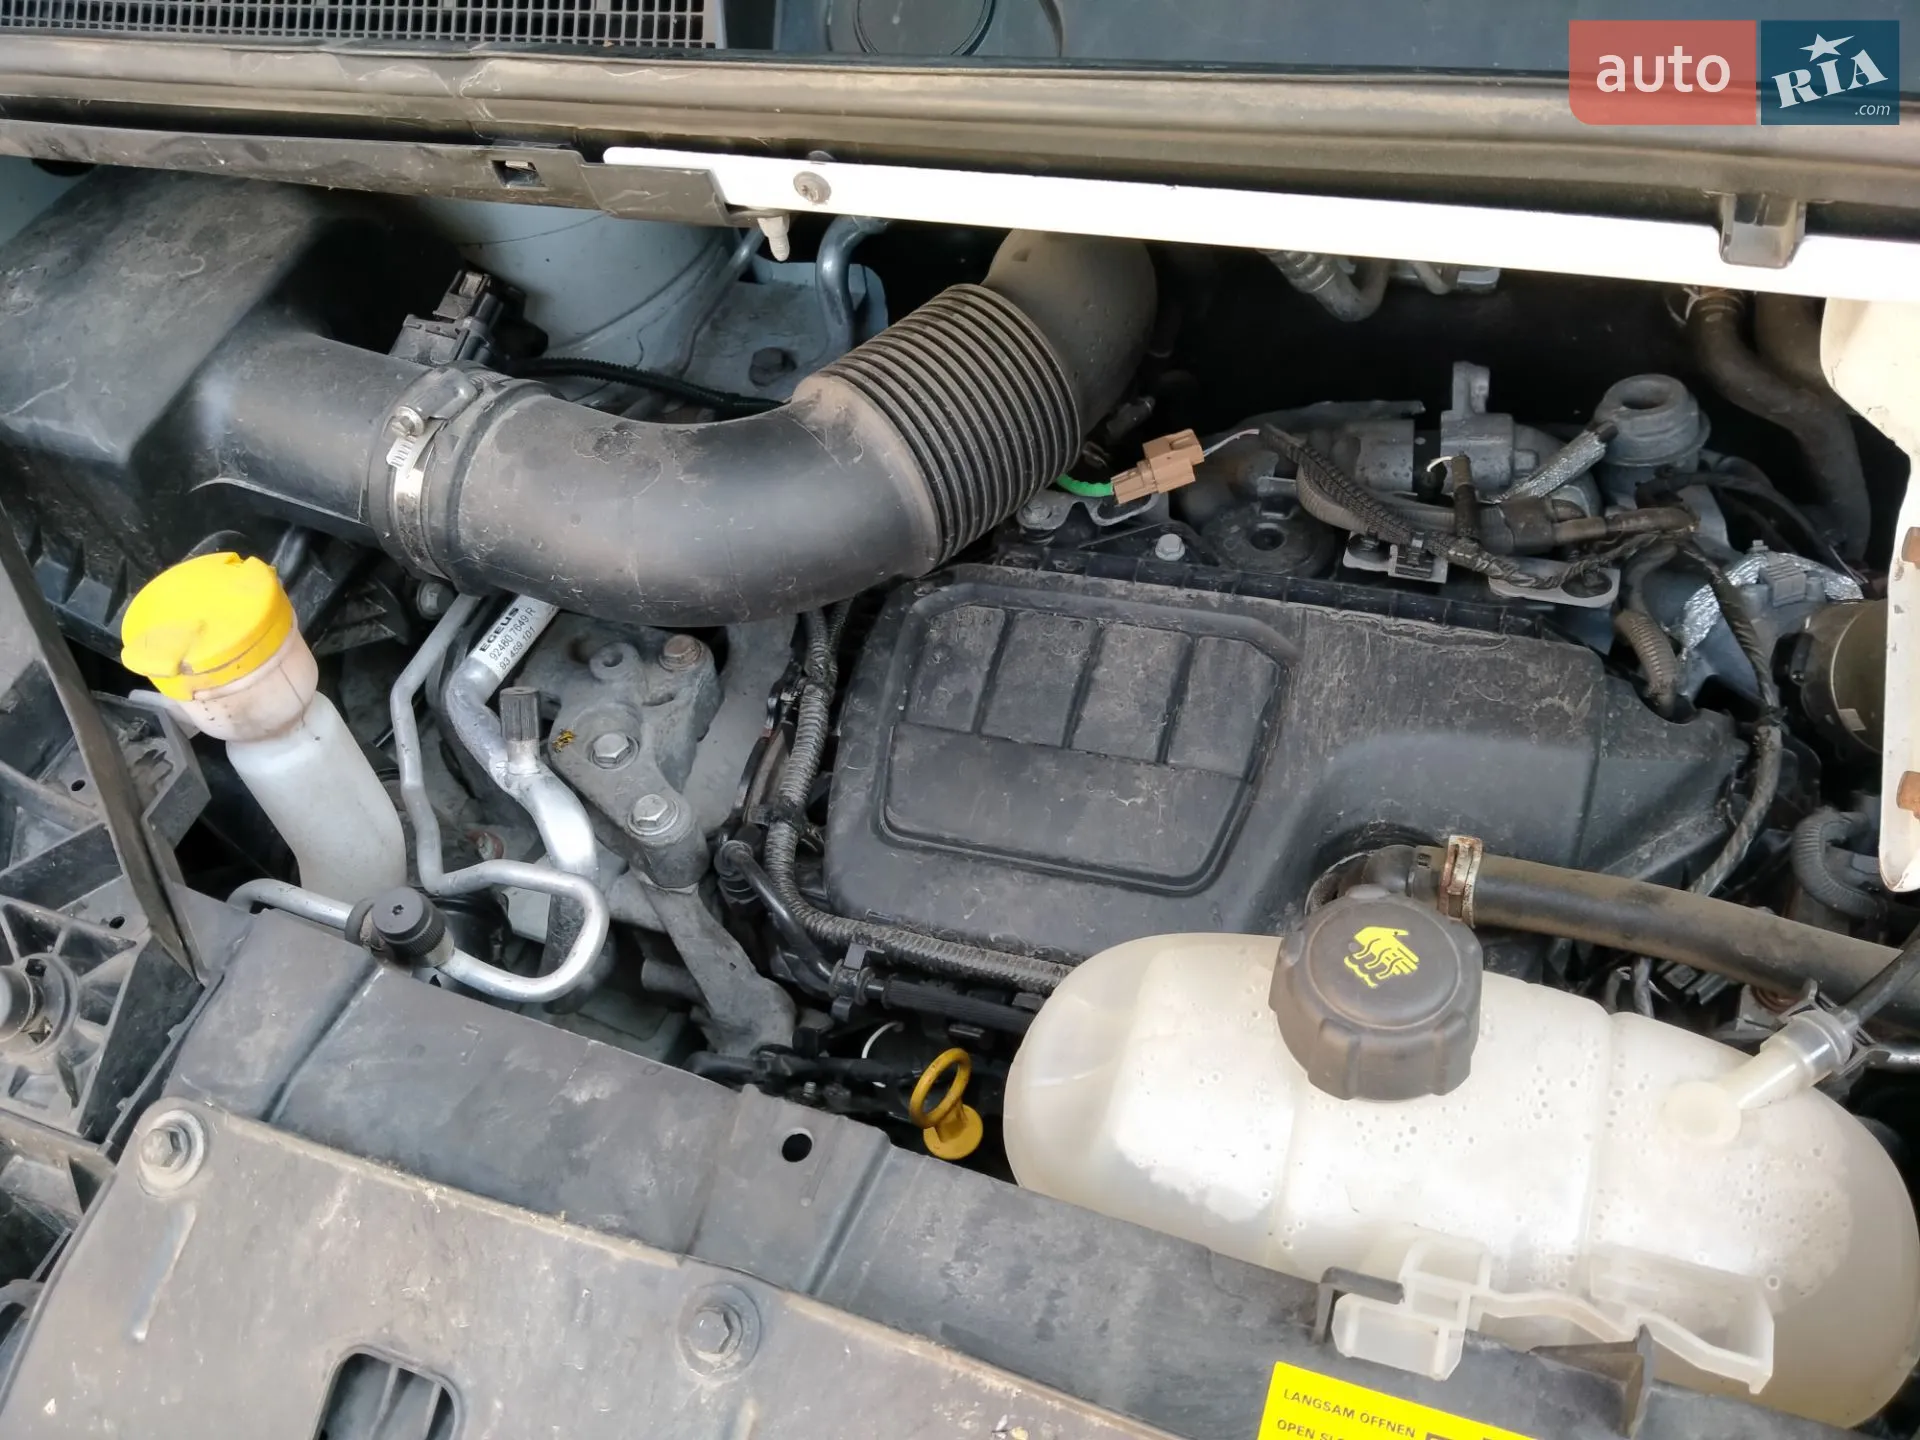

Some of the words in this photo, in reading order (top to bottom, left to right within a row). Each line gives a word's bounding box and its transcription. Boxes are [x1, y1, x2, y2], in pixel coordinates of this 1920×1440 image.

[525, 606, 537, 617] R
[1283, 1388, 1356, 1420] LANGSAM
[1277, 1419, 1316, 1440] OPEN
